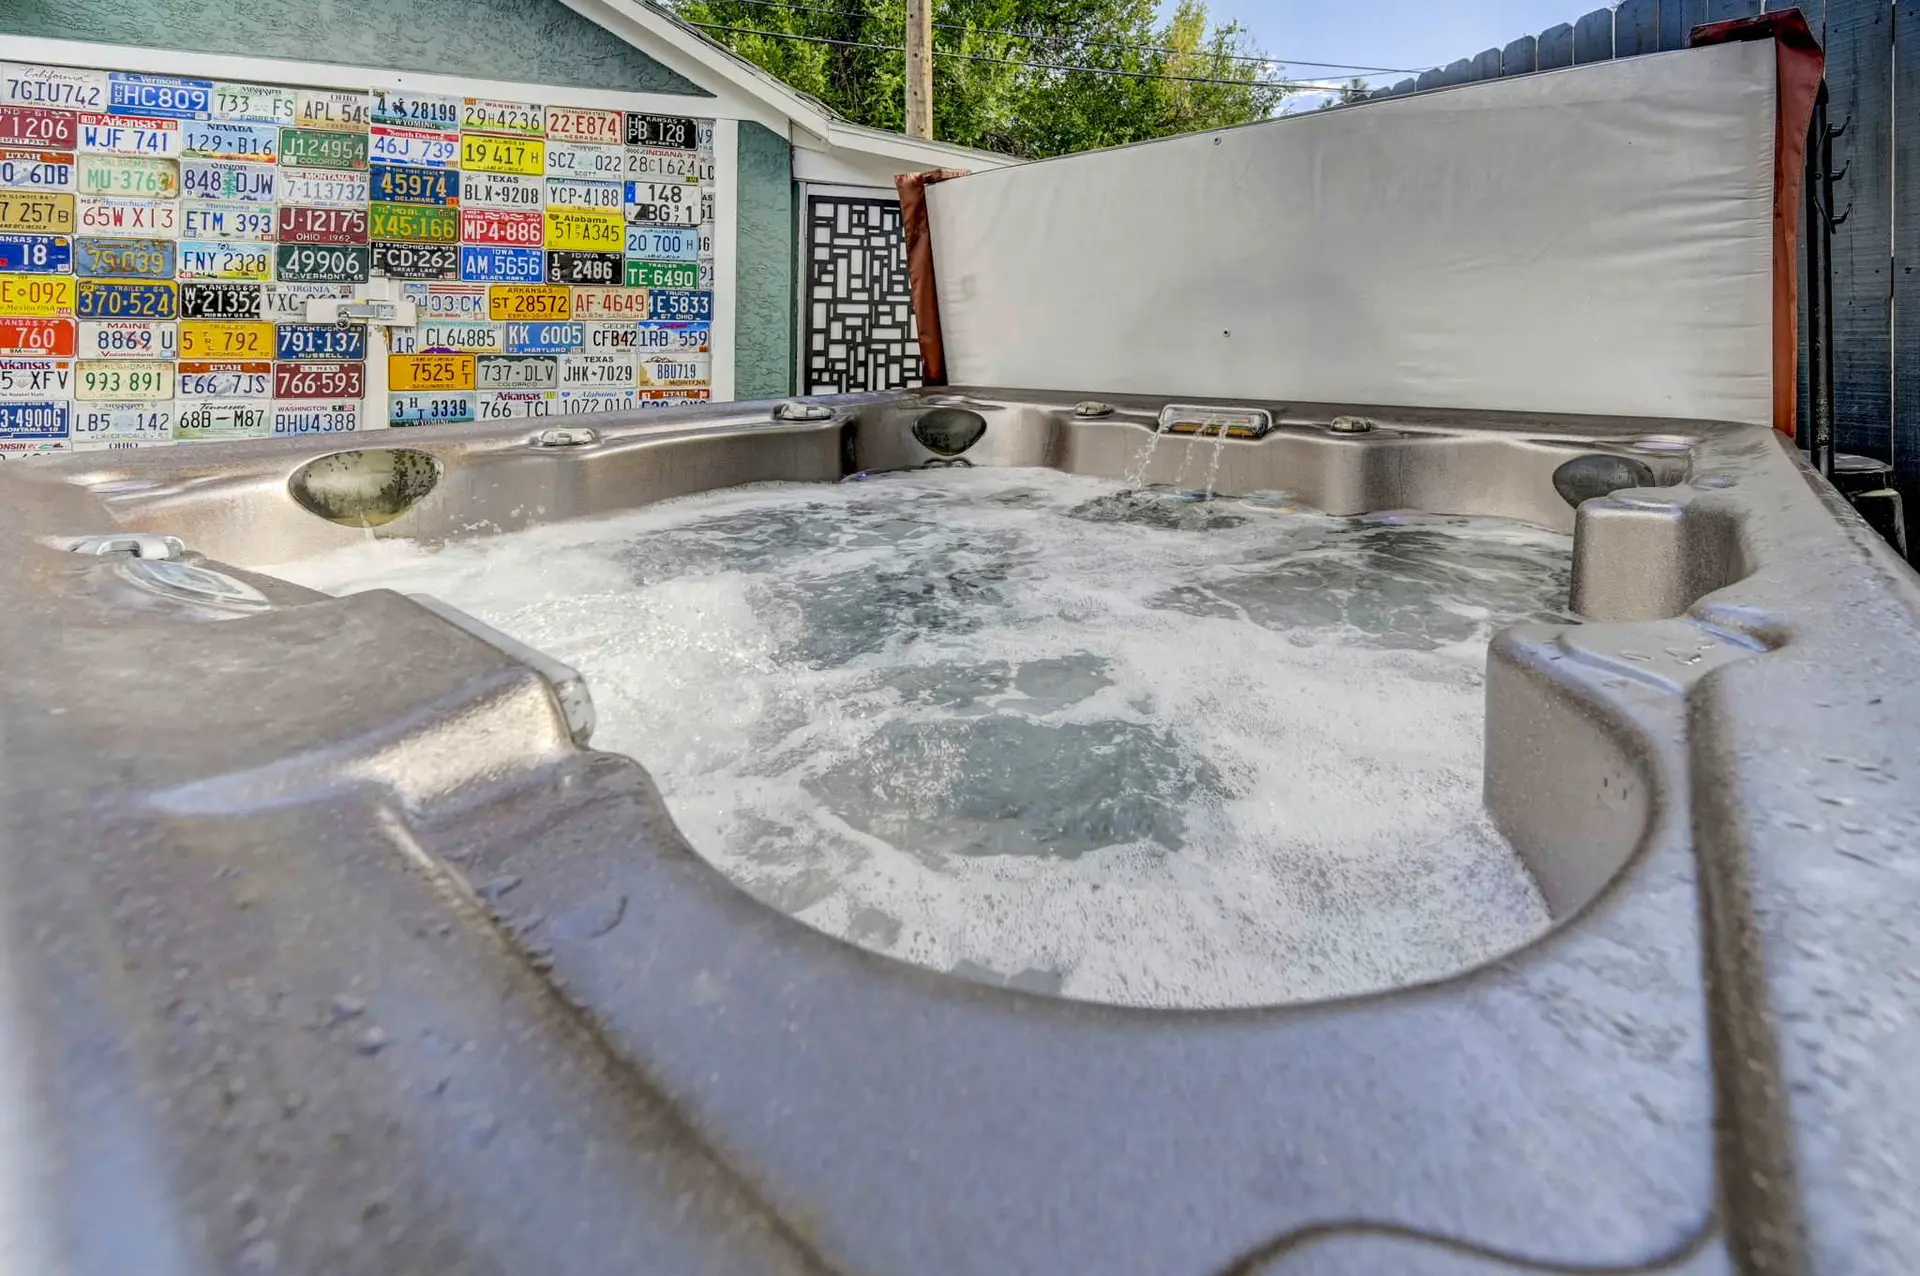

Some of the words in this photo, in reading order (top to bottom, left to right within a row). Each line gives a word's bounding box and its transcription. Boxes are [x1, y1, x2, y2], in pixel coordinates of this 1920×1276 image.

[23, 67, 89, 84] California
[140, 76, 182, 87] Vermont
[7, 79, 101, 107] 7GIU742
[124, 85, 206, 111] HC809
[217, 94, 249, 113] 733
[273, 99, 293, 117] FS
[304, 101, 335, 121] APL
[411, 101, 456, 122] 28199
[13, 117, 68, 139] 1206
[101, 115, 157, 130] Arkansas
[207, 123, 254, 134] NEVADA
[395, 118, 436, 129] WYOMING
[85, 127, 125, 148] WJF
[133, 131, 168, 152] 741
[389, 129, 414, 138] South
[415, 132, 445, 142] Dakota
[660, 123, 685, 143] 128
[6, 152, 41, 160] UTAH
[284, 137, 365, 160] J124954
[374, 136, 408, 156] 46J
[421, 140, 454, 160] 739
[465, 143, 487, 163] 19
[494, 146, 525, 167] 417
[646, 149, 683, 158] INDIANA
[211, 163, 247, 171] Oregon
[299, 157, 349, 167] COLORADO
[548, 152, 575, 169] SCZ
[595, 155, 622, 172] 022
[184, 169, 221, 190] 848
[236, 172, 274, 194] DJW
[305, 173, 351, 182] MONTANA
[381, 172, 447, 197] 45974
[487, 174, 519, 184] TEXAS
[394, 195, 436, 204] DELAWARE
[649, 184, 682, 203] 148
[20, 203, 55, 223] 257
[186, 211, 223, 231] ETM
[236, 213, 271, 233] 393
[563, 215, 608, 224] Alabama
[296, 233, 320, 241] OHIO
[329, 234, 350, 242] 1962
[393, 243, 438, 251] MICHIGAN
[628, 234, 647, 251] 20
[653, 235, 682, 252] 700
[686, 239, 693, 250] H
[23, 243, 47, 265] 18
[184, 251, 217, 271] FNY
[223, 253, 266, 273] 2328
[286, 250, 360, 274] 49906
[466, 255, 488, 274] AM
[495, 256, 540, 275] 5656
[572, 259, 613, 279] 2486
[299, 272, 346, 280] VERMONT
[286, 285, 331, 294] VIRGINIA
[492, 297, 510, 308] ST
[515, 295, 568, 312] 28572
[16, 327, 55, 348] 760
[98, 330, 152, 350] 8869
[162, 331, 173, 350] U
[183, 331, 194, 351] 5
[224, 332, 258, 351] 792
[280, 332, 361, 352] 791-137
[426, 328, 497, 347] CL64885
[509, 325, 530, 344] KK
[540, 326, 582, 344] 6005
[593, 330, 637, 347] CFB42
[679, 331, 708, 348] 559
[30, 371, 69, 390] XFV
[410, 363, 455, 382] 7525
[657, 363, 696, 379] BBU719
[86, 372, 120, 392] 993
[129, 372, 161, 391] 891
[182, 375, 217, 395] E66
[231, 375, 265, 394] 7JS
[495, 391, 541, 401] Arkansas
[582, 390, 617, 398] Alabama
[199, 402, 247, 411] Tennessee
[277, 405, 327, 413] WASHINGTON
[431, 399, 467, 418] 3339
[480, 400, 512, 418] 766
[76, 413, 111, 432] LB5
[136, 412, 169, 431] 142
[275, 413, 356, 433] BHU4388
[412, 419, 451, 427] WYOMING
[108, 442, 139, 450] OHIO
